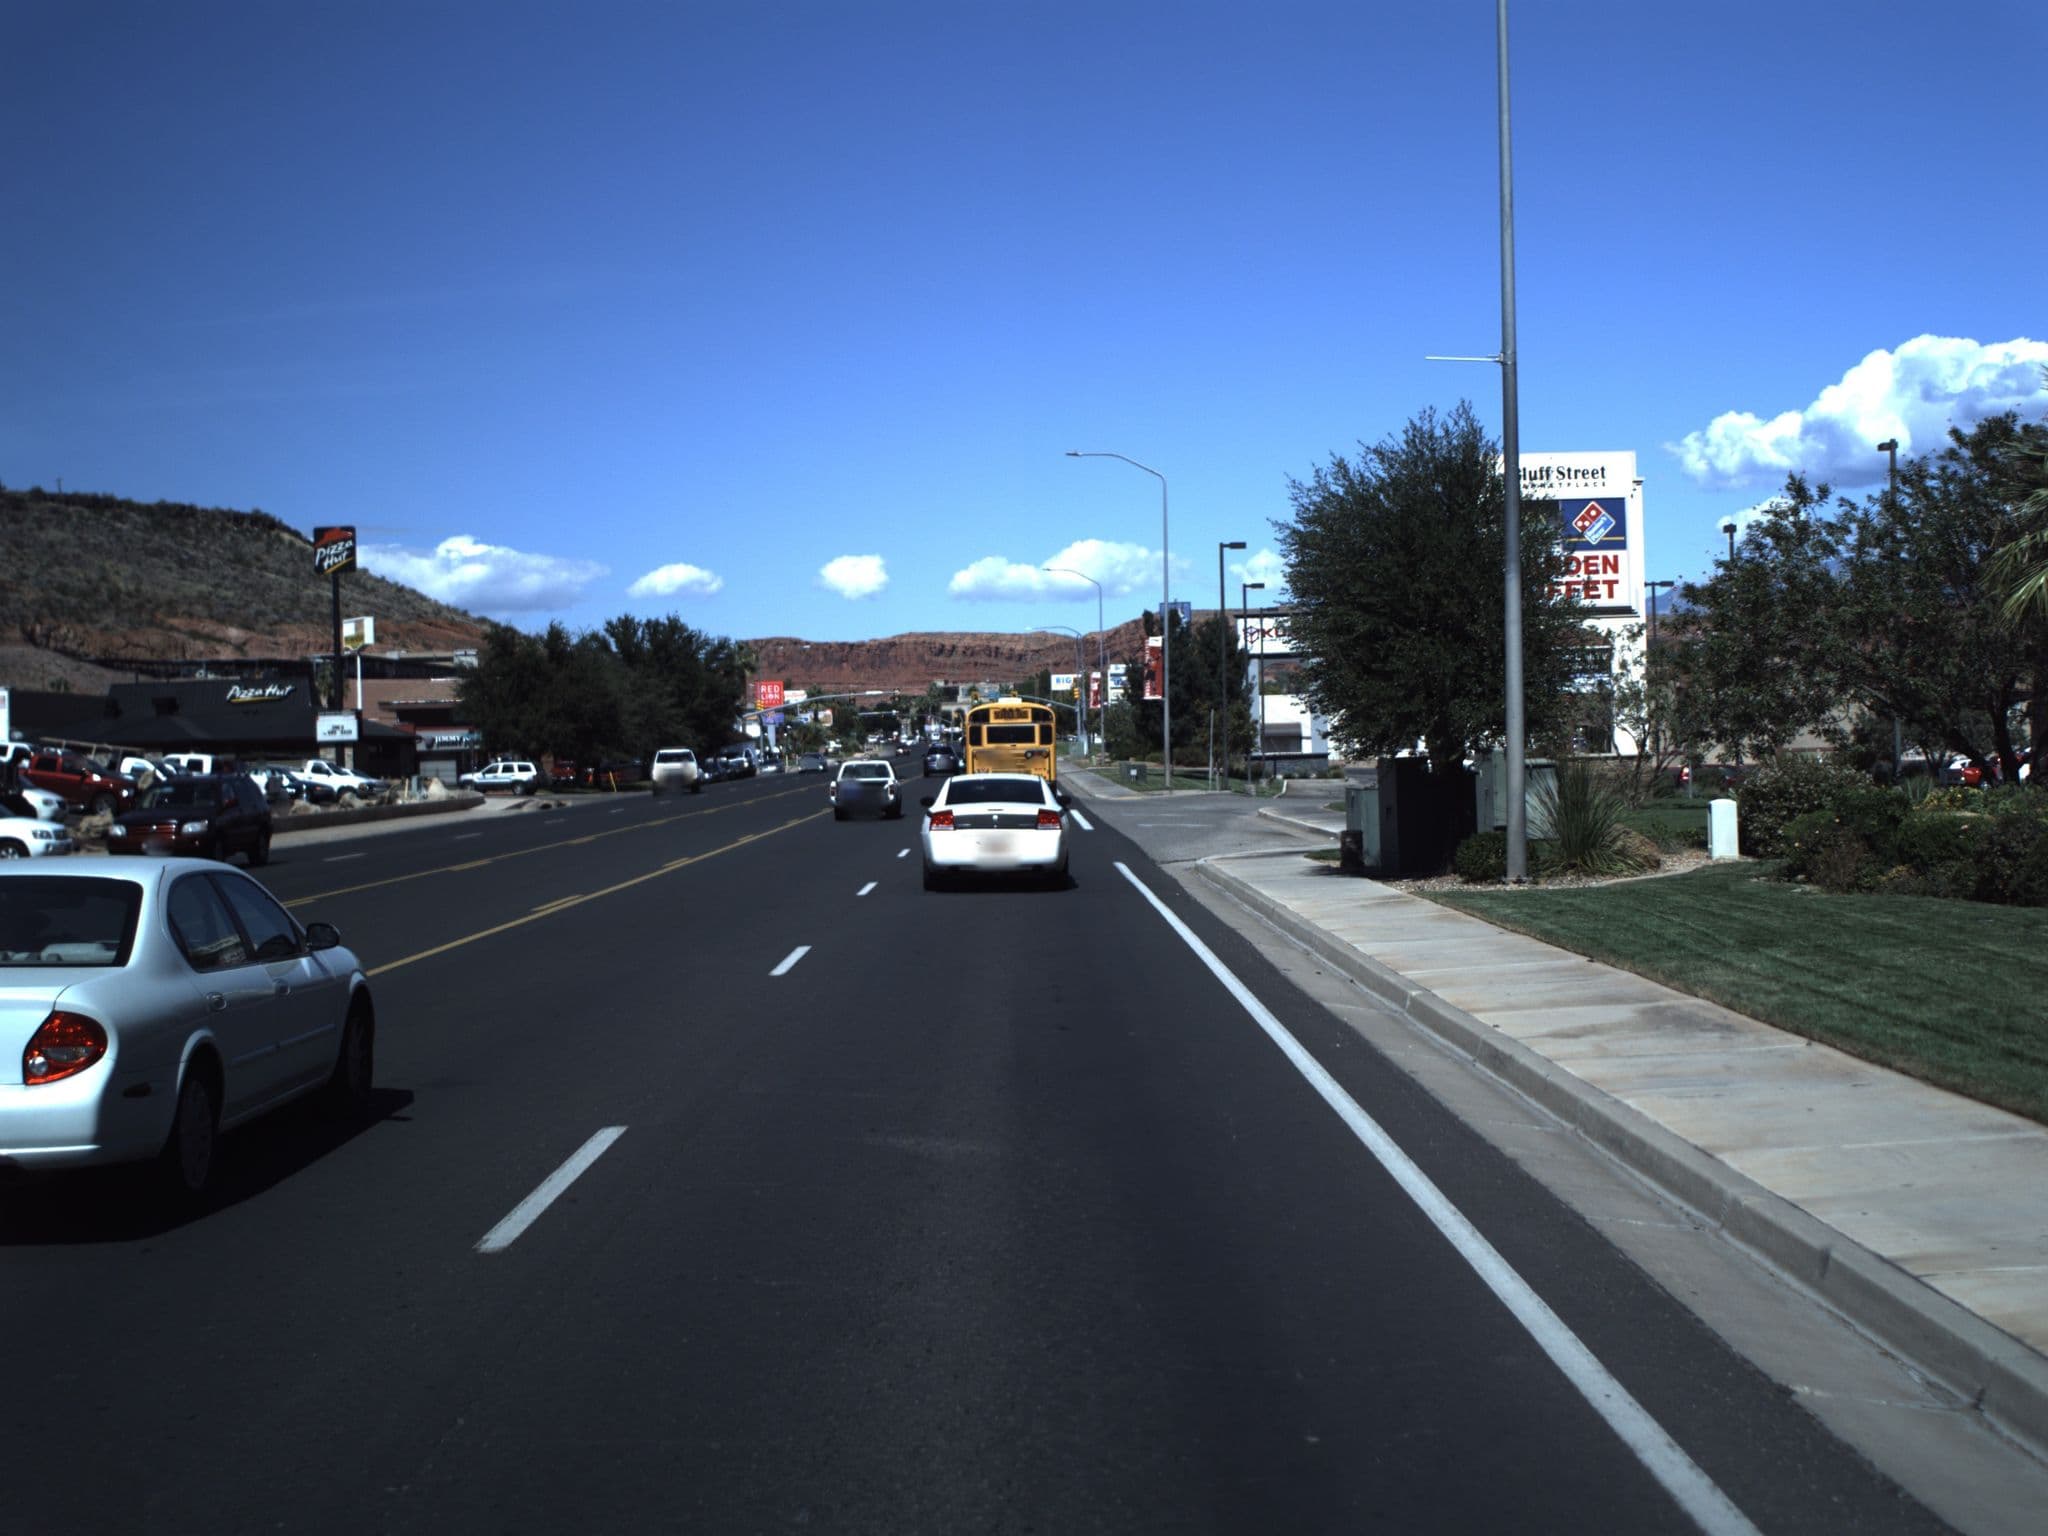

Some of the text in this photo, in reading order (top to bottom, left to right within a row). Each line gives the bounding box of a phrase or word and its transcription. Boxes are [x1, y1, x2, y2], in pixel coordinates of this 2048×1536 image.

[1518, 465, 1606, 481] luff Street
[315, 540, 353, 566] Pizza
[323, 551, 348, 570] Hut
[226, 684, 295, 700] Pizza Hut
[761, 685, 780, 693] RED
